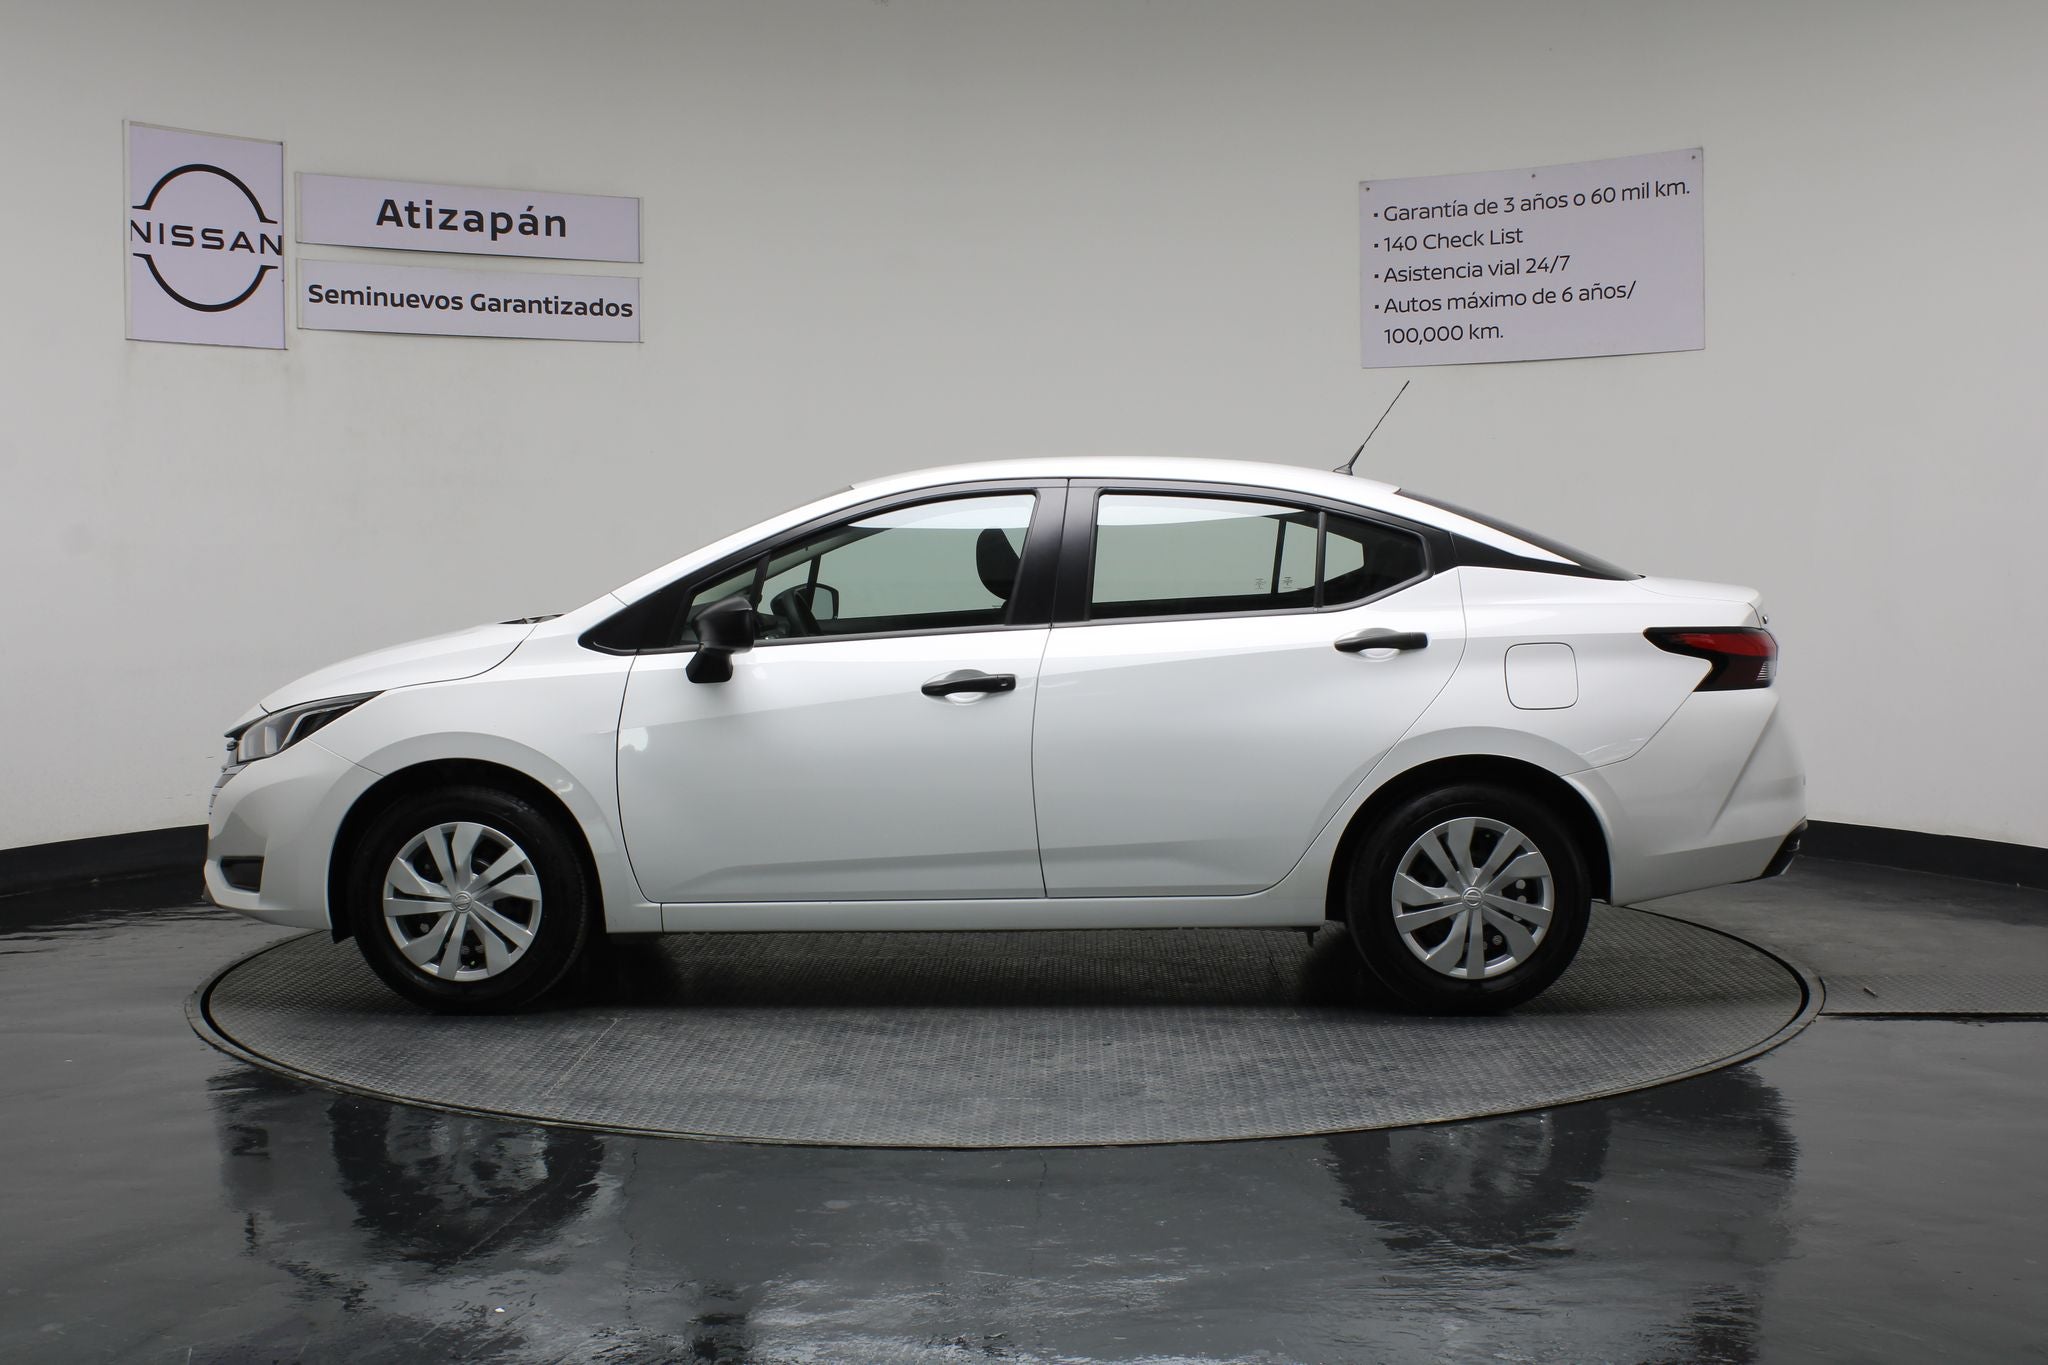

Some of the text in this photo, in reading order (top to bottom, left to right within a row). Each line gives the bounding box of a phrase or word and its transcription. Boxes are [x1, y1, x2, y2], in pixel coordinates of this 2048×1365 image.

[1383, 180, 1691, 222] Garantía de 3 años o 60 mil km.
[375, 198, 567, 241] Atizapán
[130, 219, 284, 257] NISSAN
[1383, 227, 1524, 253] 140 Check List
[1383, 254, 1571, 284] Asistencia vial 24/7
[308, 284, 634, 318] Seminuevos Garantizados
[1383, 279, 1637, 314] Autos máximo de 6 años/
[1383, 323, 1504, 346] 100,000 km.
